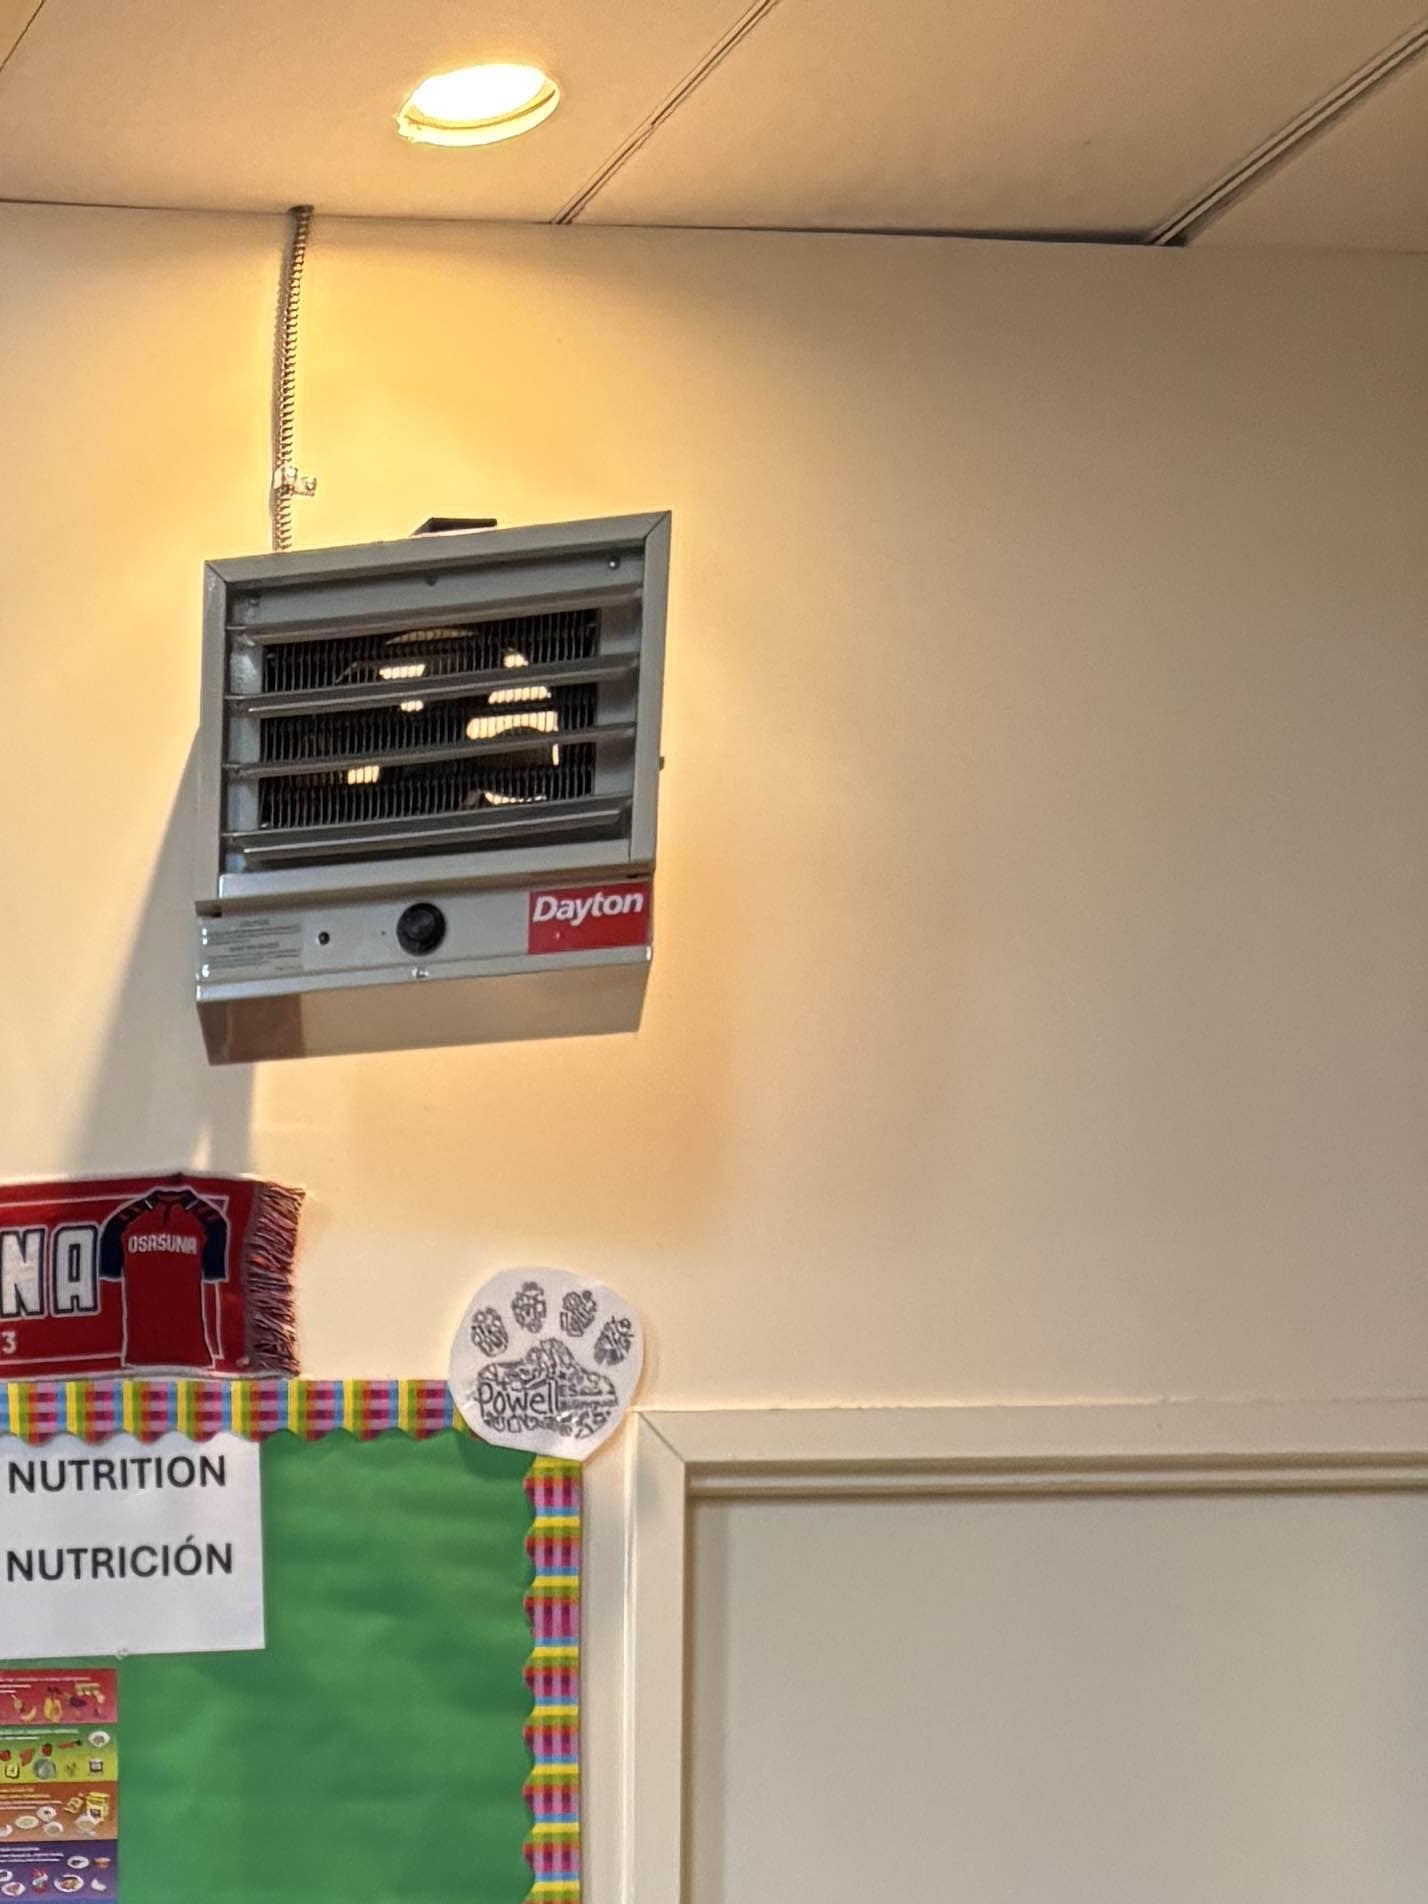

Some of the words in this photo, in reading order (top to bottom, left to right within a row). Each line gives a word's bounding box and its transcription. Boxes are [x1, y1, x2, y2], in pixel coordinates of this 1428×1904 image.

[531, 889, 645, 929] Dayton
[127, 1230, 198, 1257] OSASUNA
[6, 1453, 228, 1495] NUTRITION
[5, 1538, 235, 1583] NUTRICIÓN
